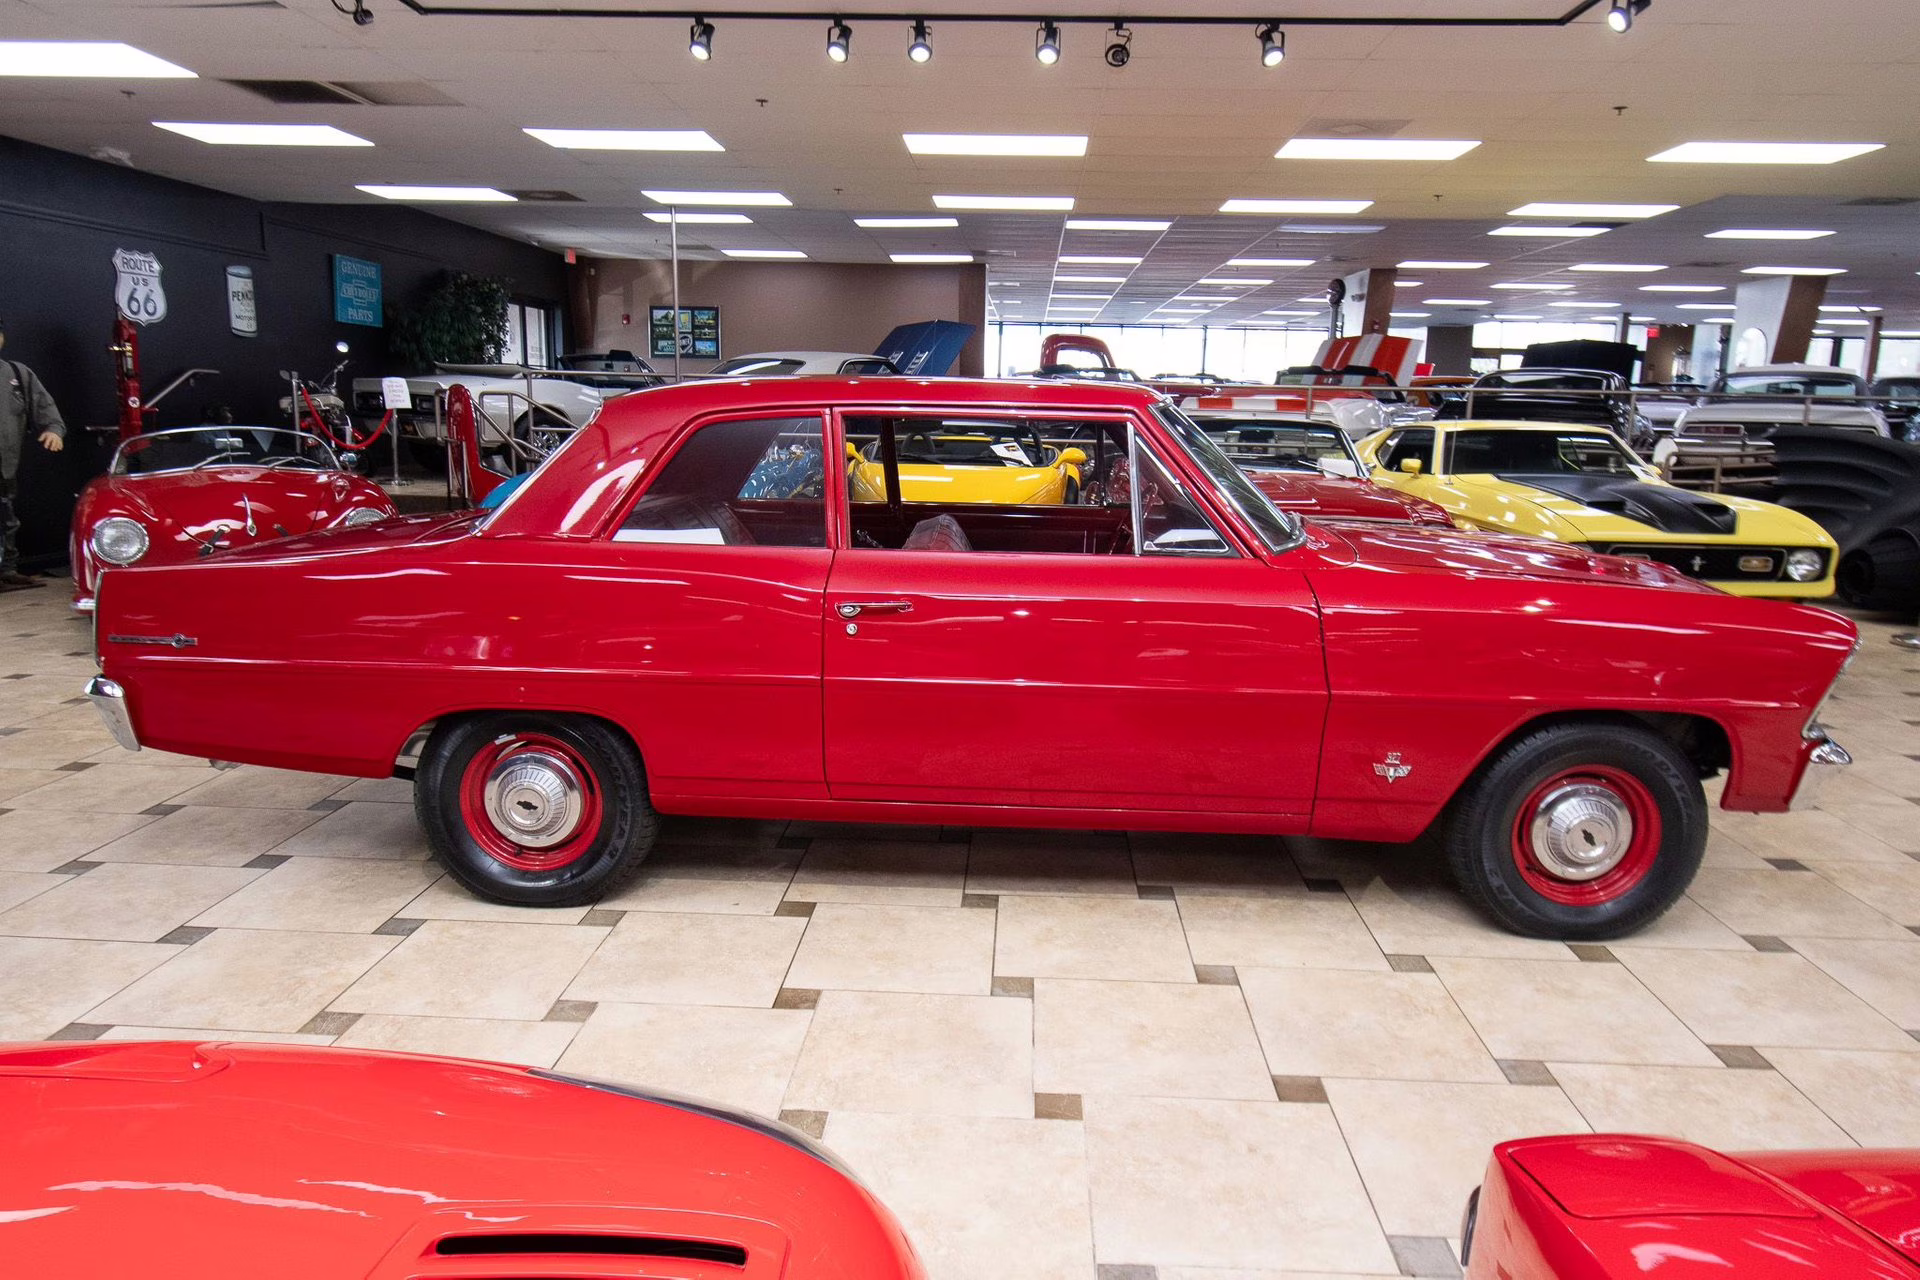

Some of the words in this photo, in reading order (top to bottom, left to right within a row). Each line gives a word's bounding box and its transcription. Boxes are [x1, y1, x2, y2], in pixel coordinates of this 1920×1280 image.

[122, 257, 155, 273] ROUTE
[341, 261, 377, 279] GENUINE
[128, 288, 157, 316] 66
[348, 308, 374, 322] PARTS
